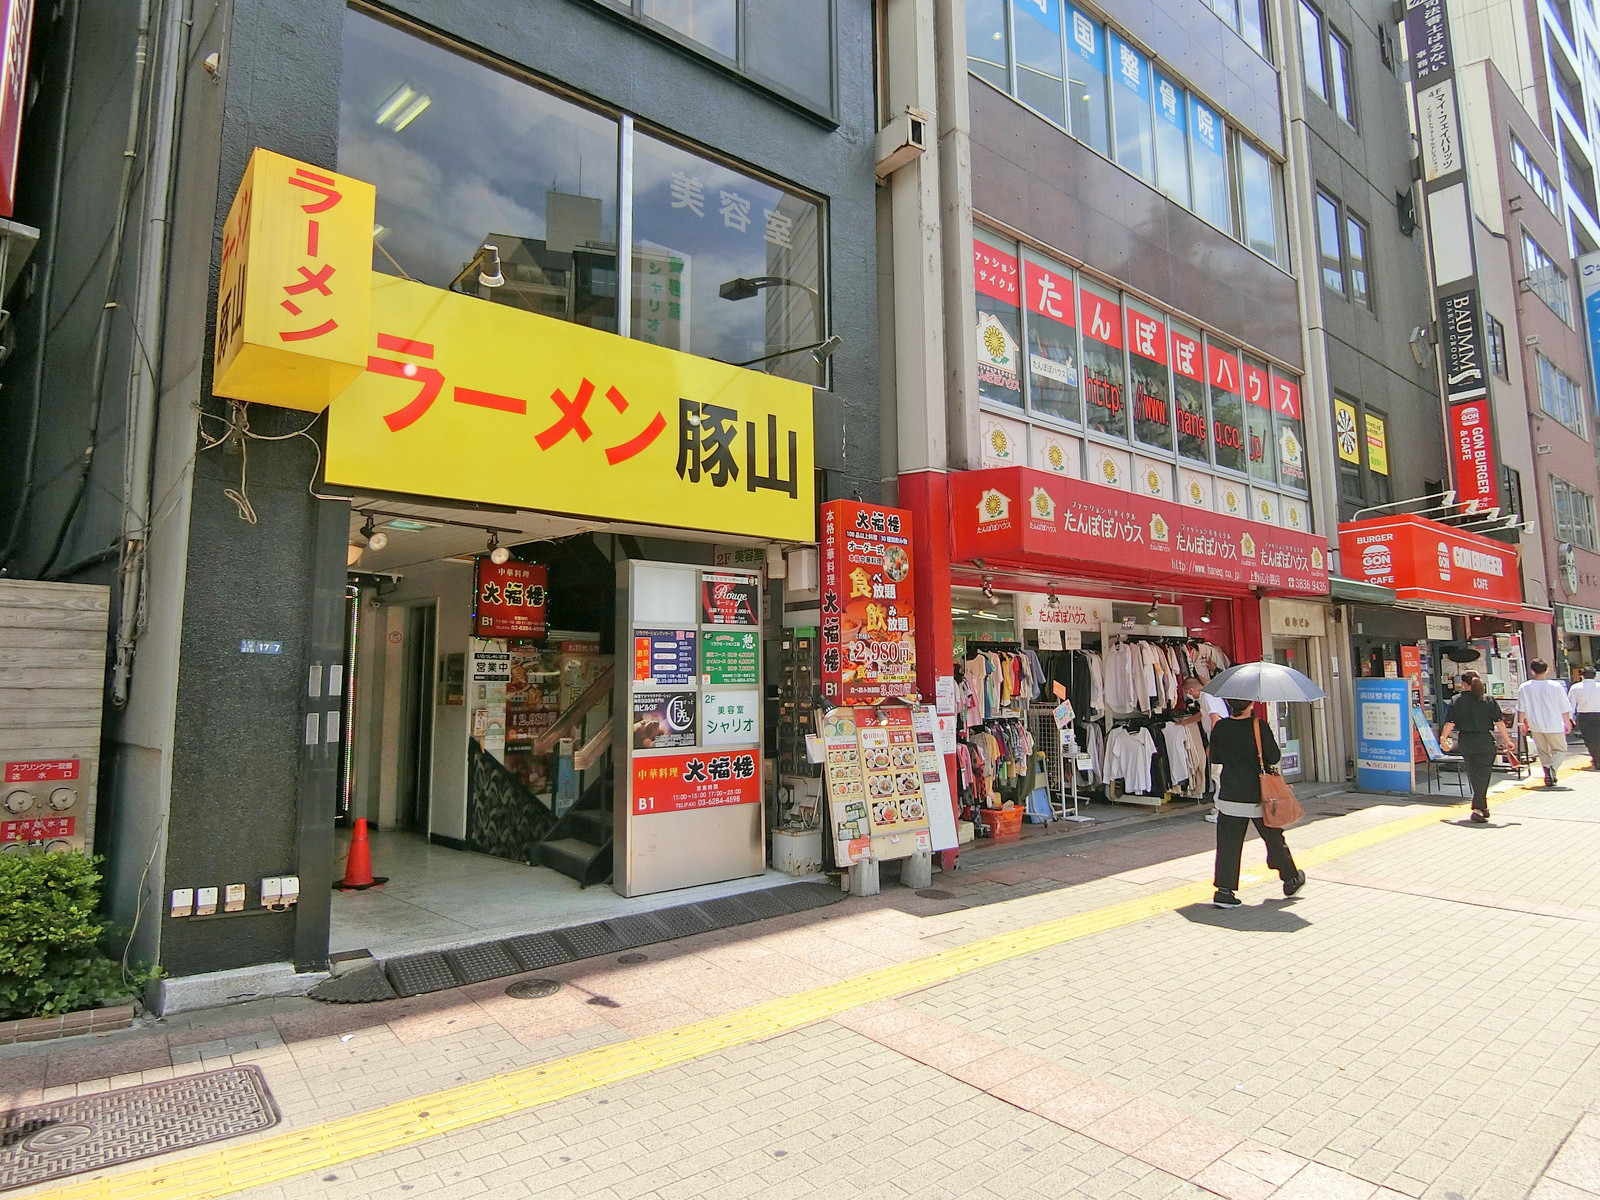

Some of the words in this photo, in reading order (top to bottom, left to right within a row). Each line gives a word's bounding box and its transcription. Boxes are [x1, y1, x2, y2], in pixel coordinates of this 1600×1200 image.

[1027, 0, 1214, 140] 国整骨院
[670, 171, 793, 250] 美容室
[278, 167, 343, 342] ラーメン
[1446, 300, 1456, 330] DARTS
[1037, 273, 1296, 416] たんぽぽハウス
[1449, 334, 1460, 372] GROOVY
[1472, 426, 1485, 449] GON
[1460, 437, 1472, 461] CAFE
[1474, 450, 1490, 494] BURGER
[976, 521, 1013, 534] たんぽぽハウス
[1029, 521, 1058, 534] たんぽぽハウス
[1064, 508, 1145, 545] たんぽぽハウス
[1176, 531, 1239, 561] たんぽぽハウス
[1356, 533, 1394, 545] BURGER
[826, 509, 835, 586] 本格中華料理
[848, 541, 885, 556] オーダー式
[1260, 548, 1310, 573] たんぽぽハウス
[1362, 554, 1391, 567] GON
[1438, 555, 1450, 569] GON
[1452, 545, 1472, 570] GON
[1471, 550, 1504, 577] BURGER
[498, 567, 530, 579] 中華料理
[1370, 575, 1394, 585] CAFE
[1477, 577, 1489, 590] CAFE
[714, 583, 748, 607] Rouge
[482, 616, 493, 626] B1
[1038, 608, 1088, 625] たんぽぽハウス
[259, 643, 270, 651] 17
[274, 644, 280, 652] 7
[476, 662, 508, 673] 営業中
[825, 682, 839, 696] B1
[704, 694, 716, 704] 2F
[717, 705, 745, 715] 美容室
[707, 718, 754, 735] シャリオ
[12, 762, 73, 772] スプリンクラー設備
[638, 767, 678, 780] 中華料理
[638, 796, 655, 811] B1
[697, 795, 741, 807] 03-6284-4598
